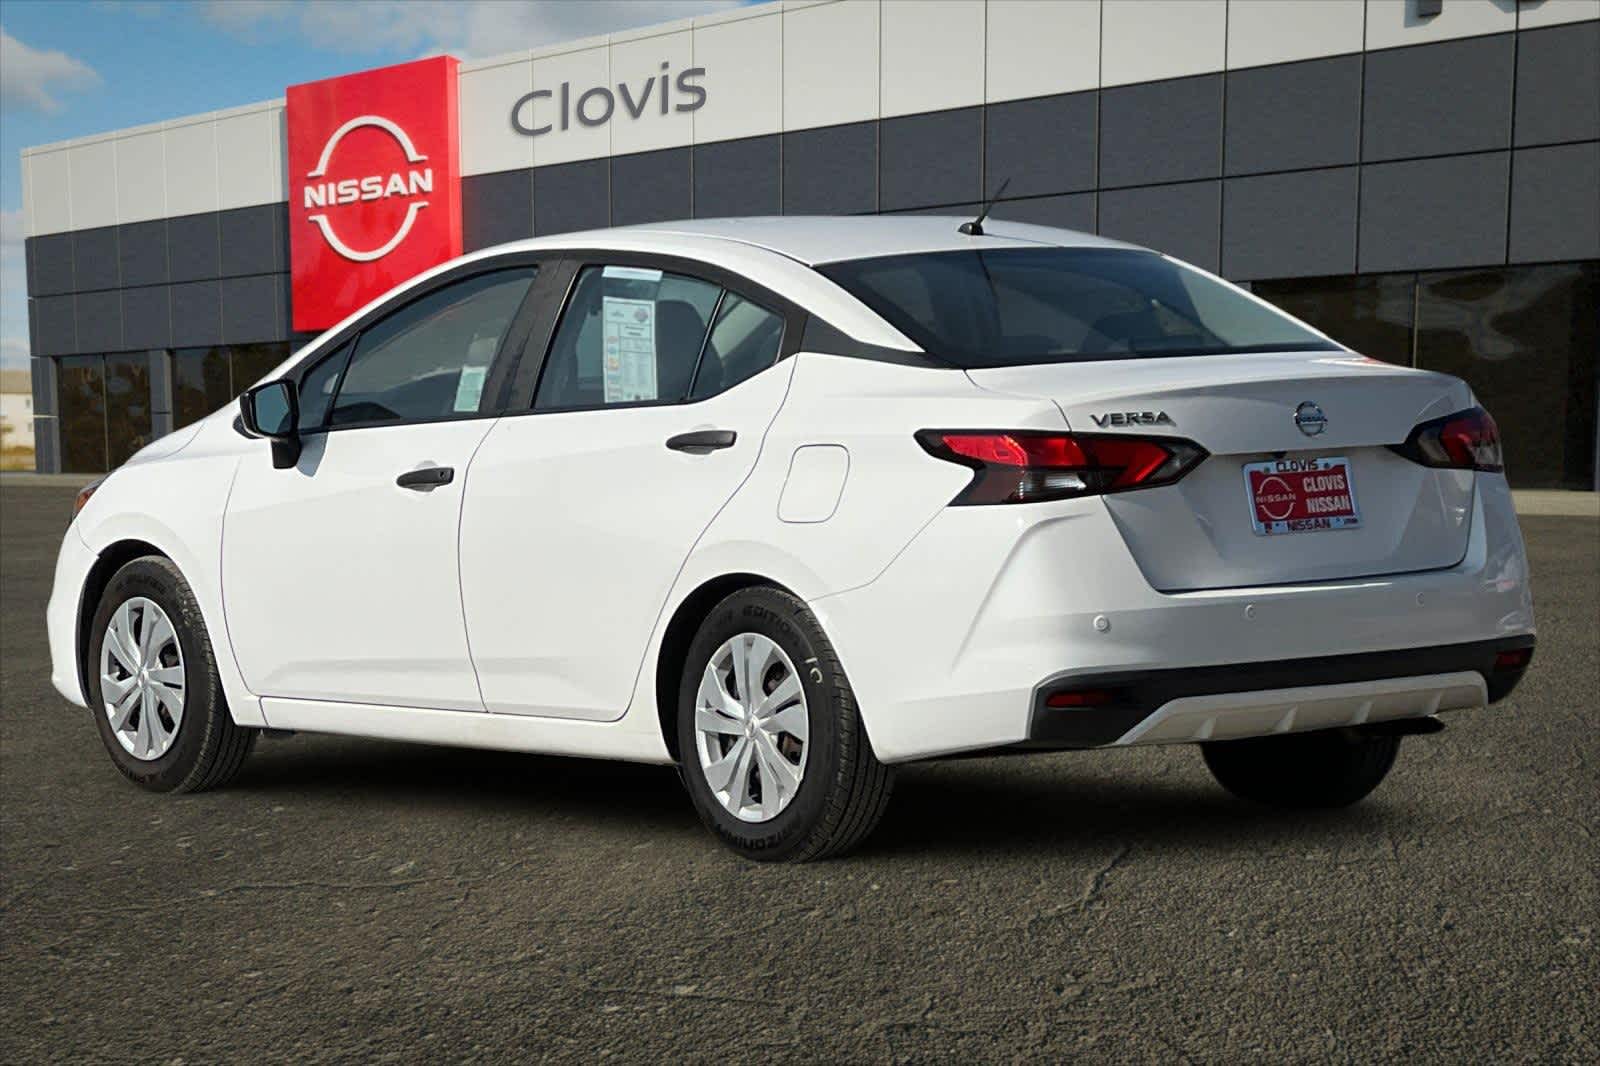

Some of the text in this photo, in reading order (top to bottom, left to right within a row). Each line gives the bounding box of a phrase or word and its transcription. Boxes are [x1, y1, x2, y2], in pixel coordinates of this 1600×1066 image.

[510, 61, 707, 136] Clovis
[304, 168, 433, 208] NISSAN
[1090, 411, 1177, 428] VERSA
[1276, 460, 1319, 473] CLOVIS
[1303, 475, 1345, 493] CLOVIS
[1306, 495, 1350, 513] NISSAN
